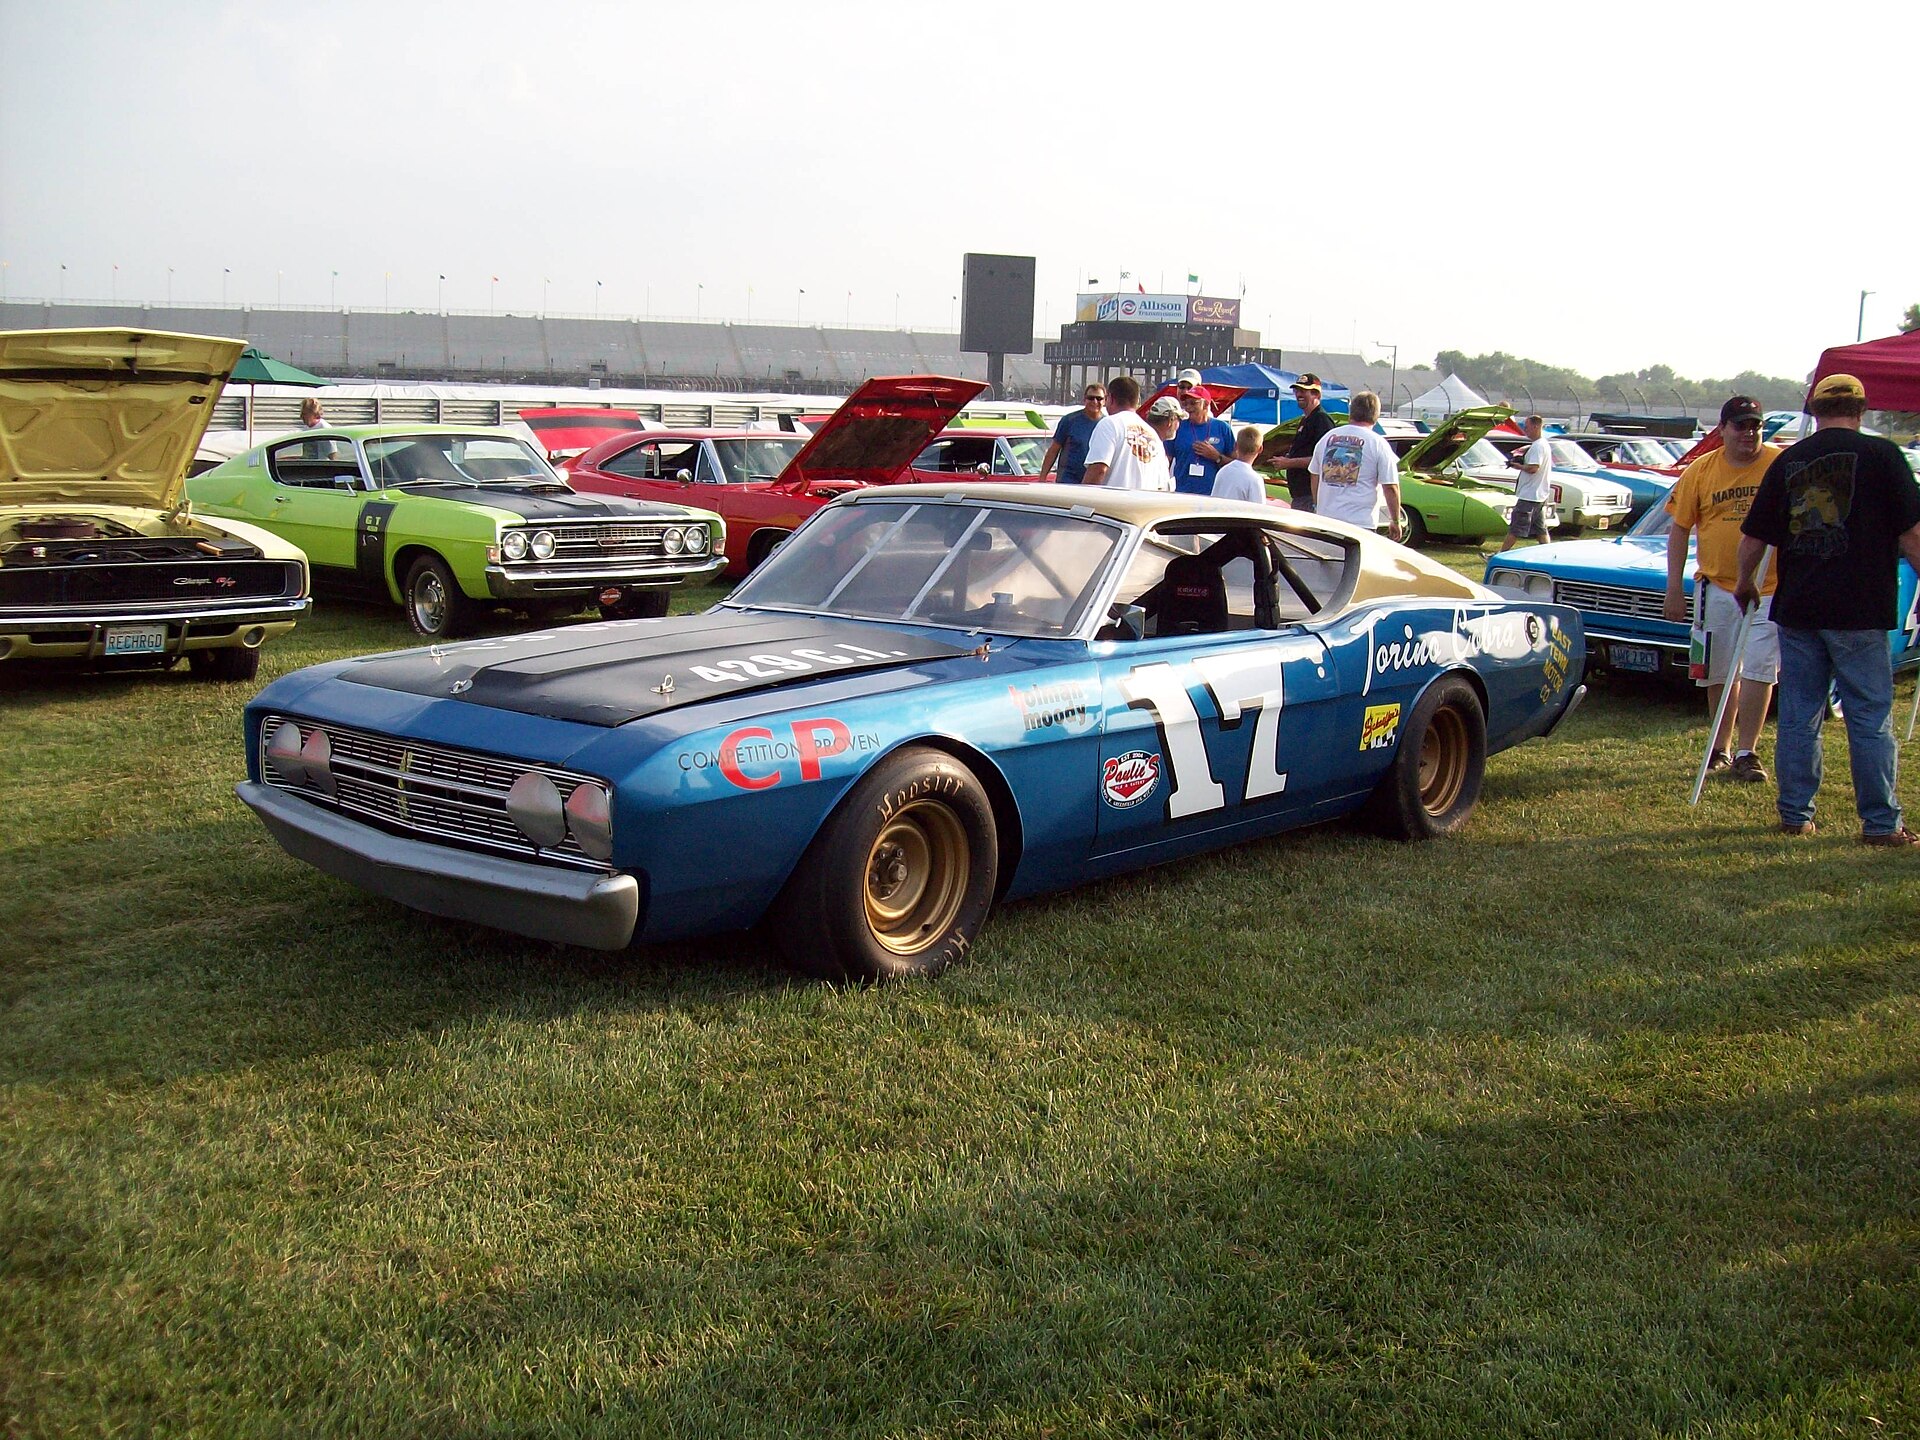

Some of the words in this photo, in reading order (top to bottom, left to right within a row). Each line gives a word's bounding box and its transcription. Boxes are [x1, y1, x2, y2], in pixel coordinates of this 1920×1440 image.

[1139, 300, 1182, 311] Allison
[1192, 299, 1214, 315] Crown
[1207, 301, 1236, 318] Royal
[365, 515, 382, 526] GT
[108, 634, 162, 650] RECHRGD
[1349, 608, 1441, 697] Torino
[1452, 605, 1516, 660] Cobra
[689, 654, 813, 682] 429
[1543, 658, 1563, 693] MOTOR
[1122, 648, 1288, 818] 17
[678, 741, 803, 771] COMPETITION
[814, 733, 881, 755] PROVEN
[718, 717, 852, 791] CP
